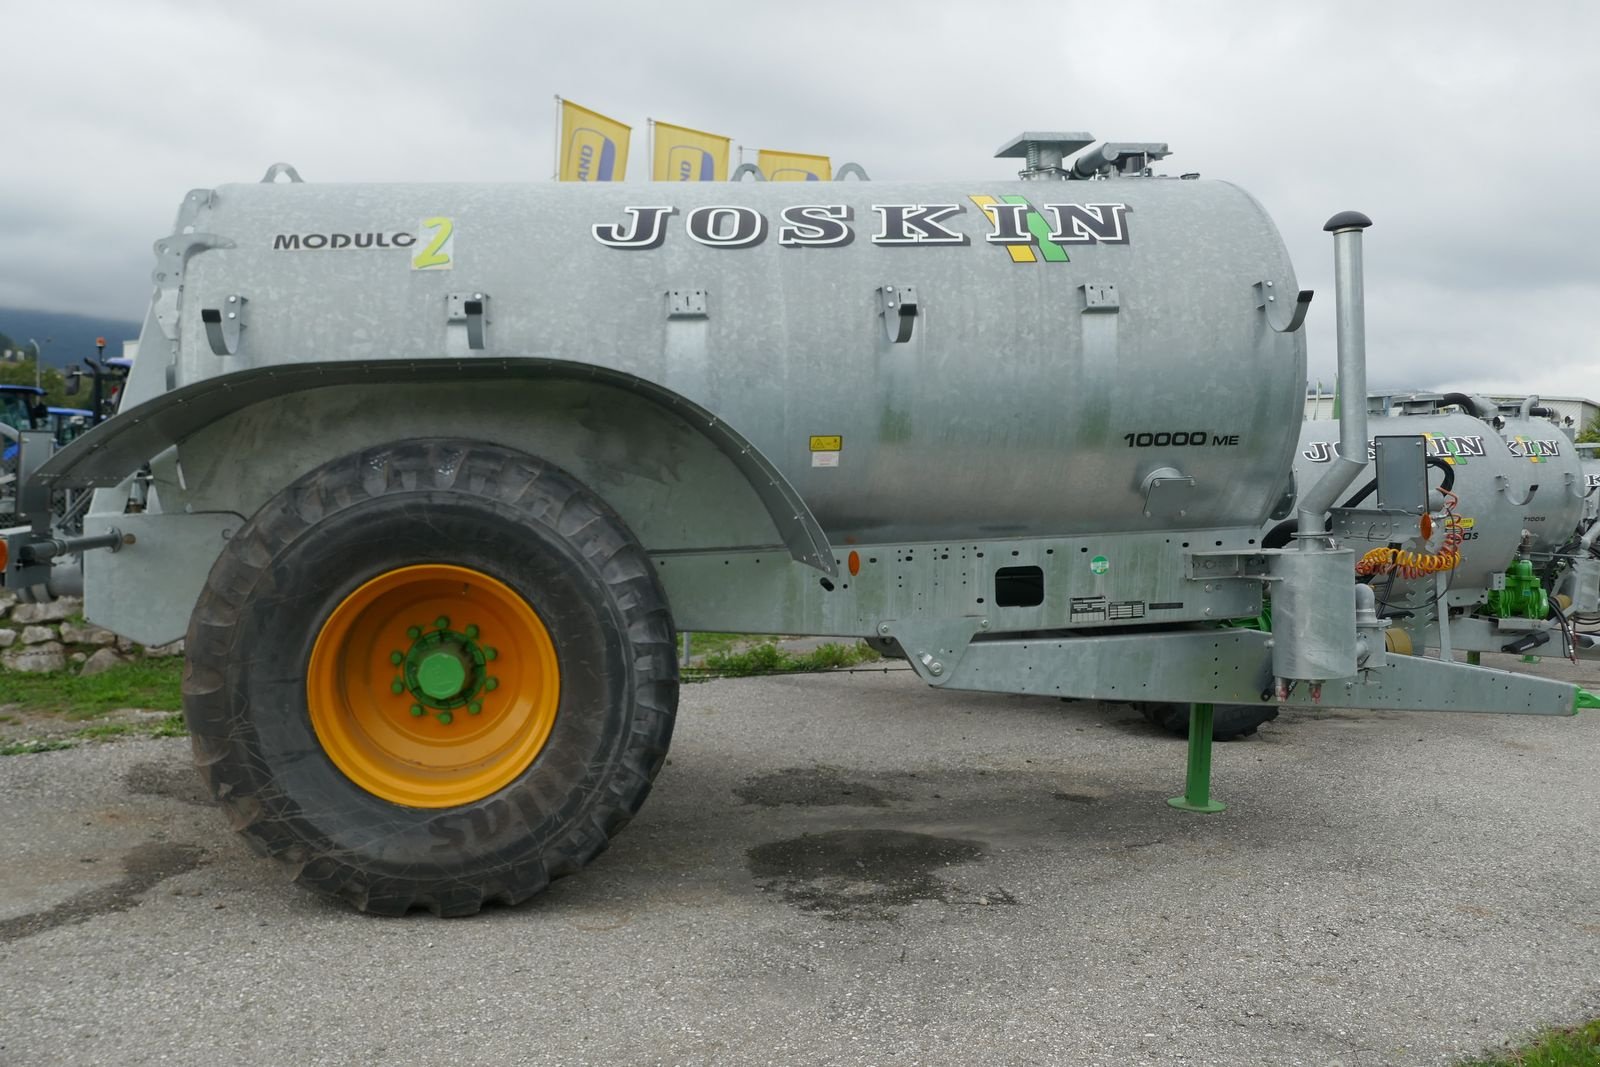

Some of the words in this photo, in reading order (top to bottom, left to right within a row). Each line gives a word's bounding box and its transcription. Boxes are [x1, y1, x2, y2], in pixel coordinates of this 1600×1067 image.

[413, 216, 454, 269] 2
[591, 203, 1133, 250] JOSKIN
[1124, 431, 1207, 448] 10000
[1212, 435, 1239, 446] ME
